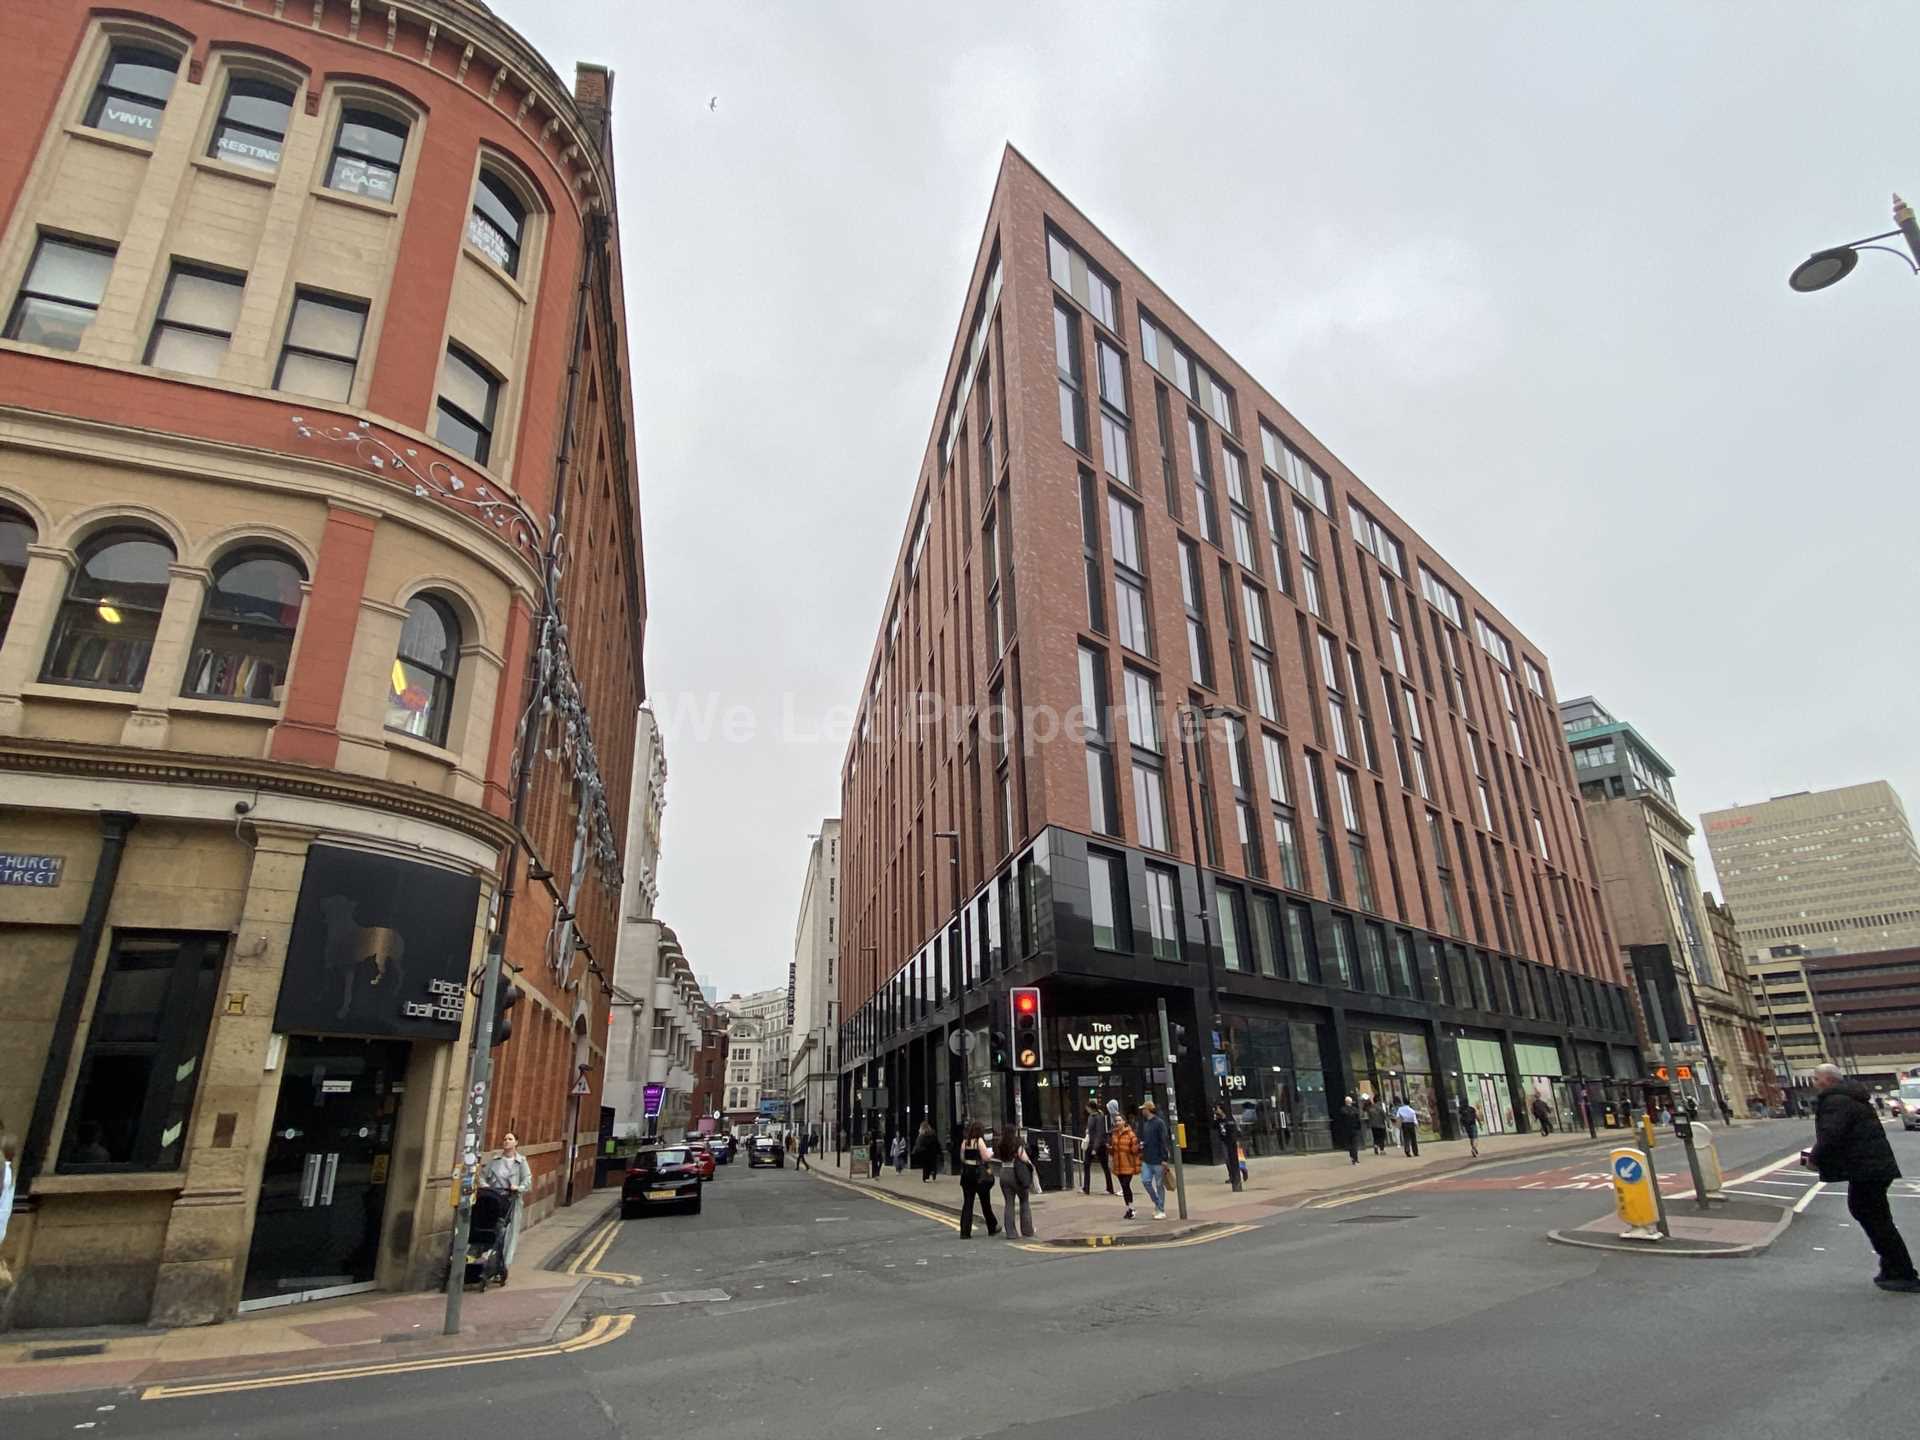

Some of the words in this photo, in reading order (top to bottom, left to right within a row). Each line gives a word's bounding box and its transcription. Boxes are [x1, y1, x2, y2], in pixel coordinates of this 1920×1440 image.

[107, 108, 153, 129] VINYL
[0, 870, 57, 884] TREET
[1092, 1022, 1112, 1032] The
[1067, 1033, 1139, 1055] Vurger
